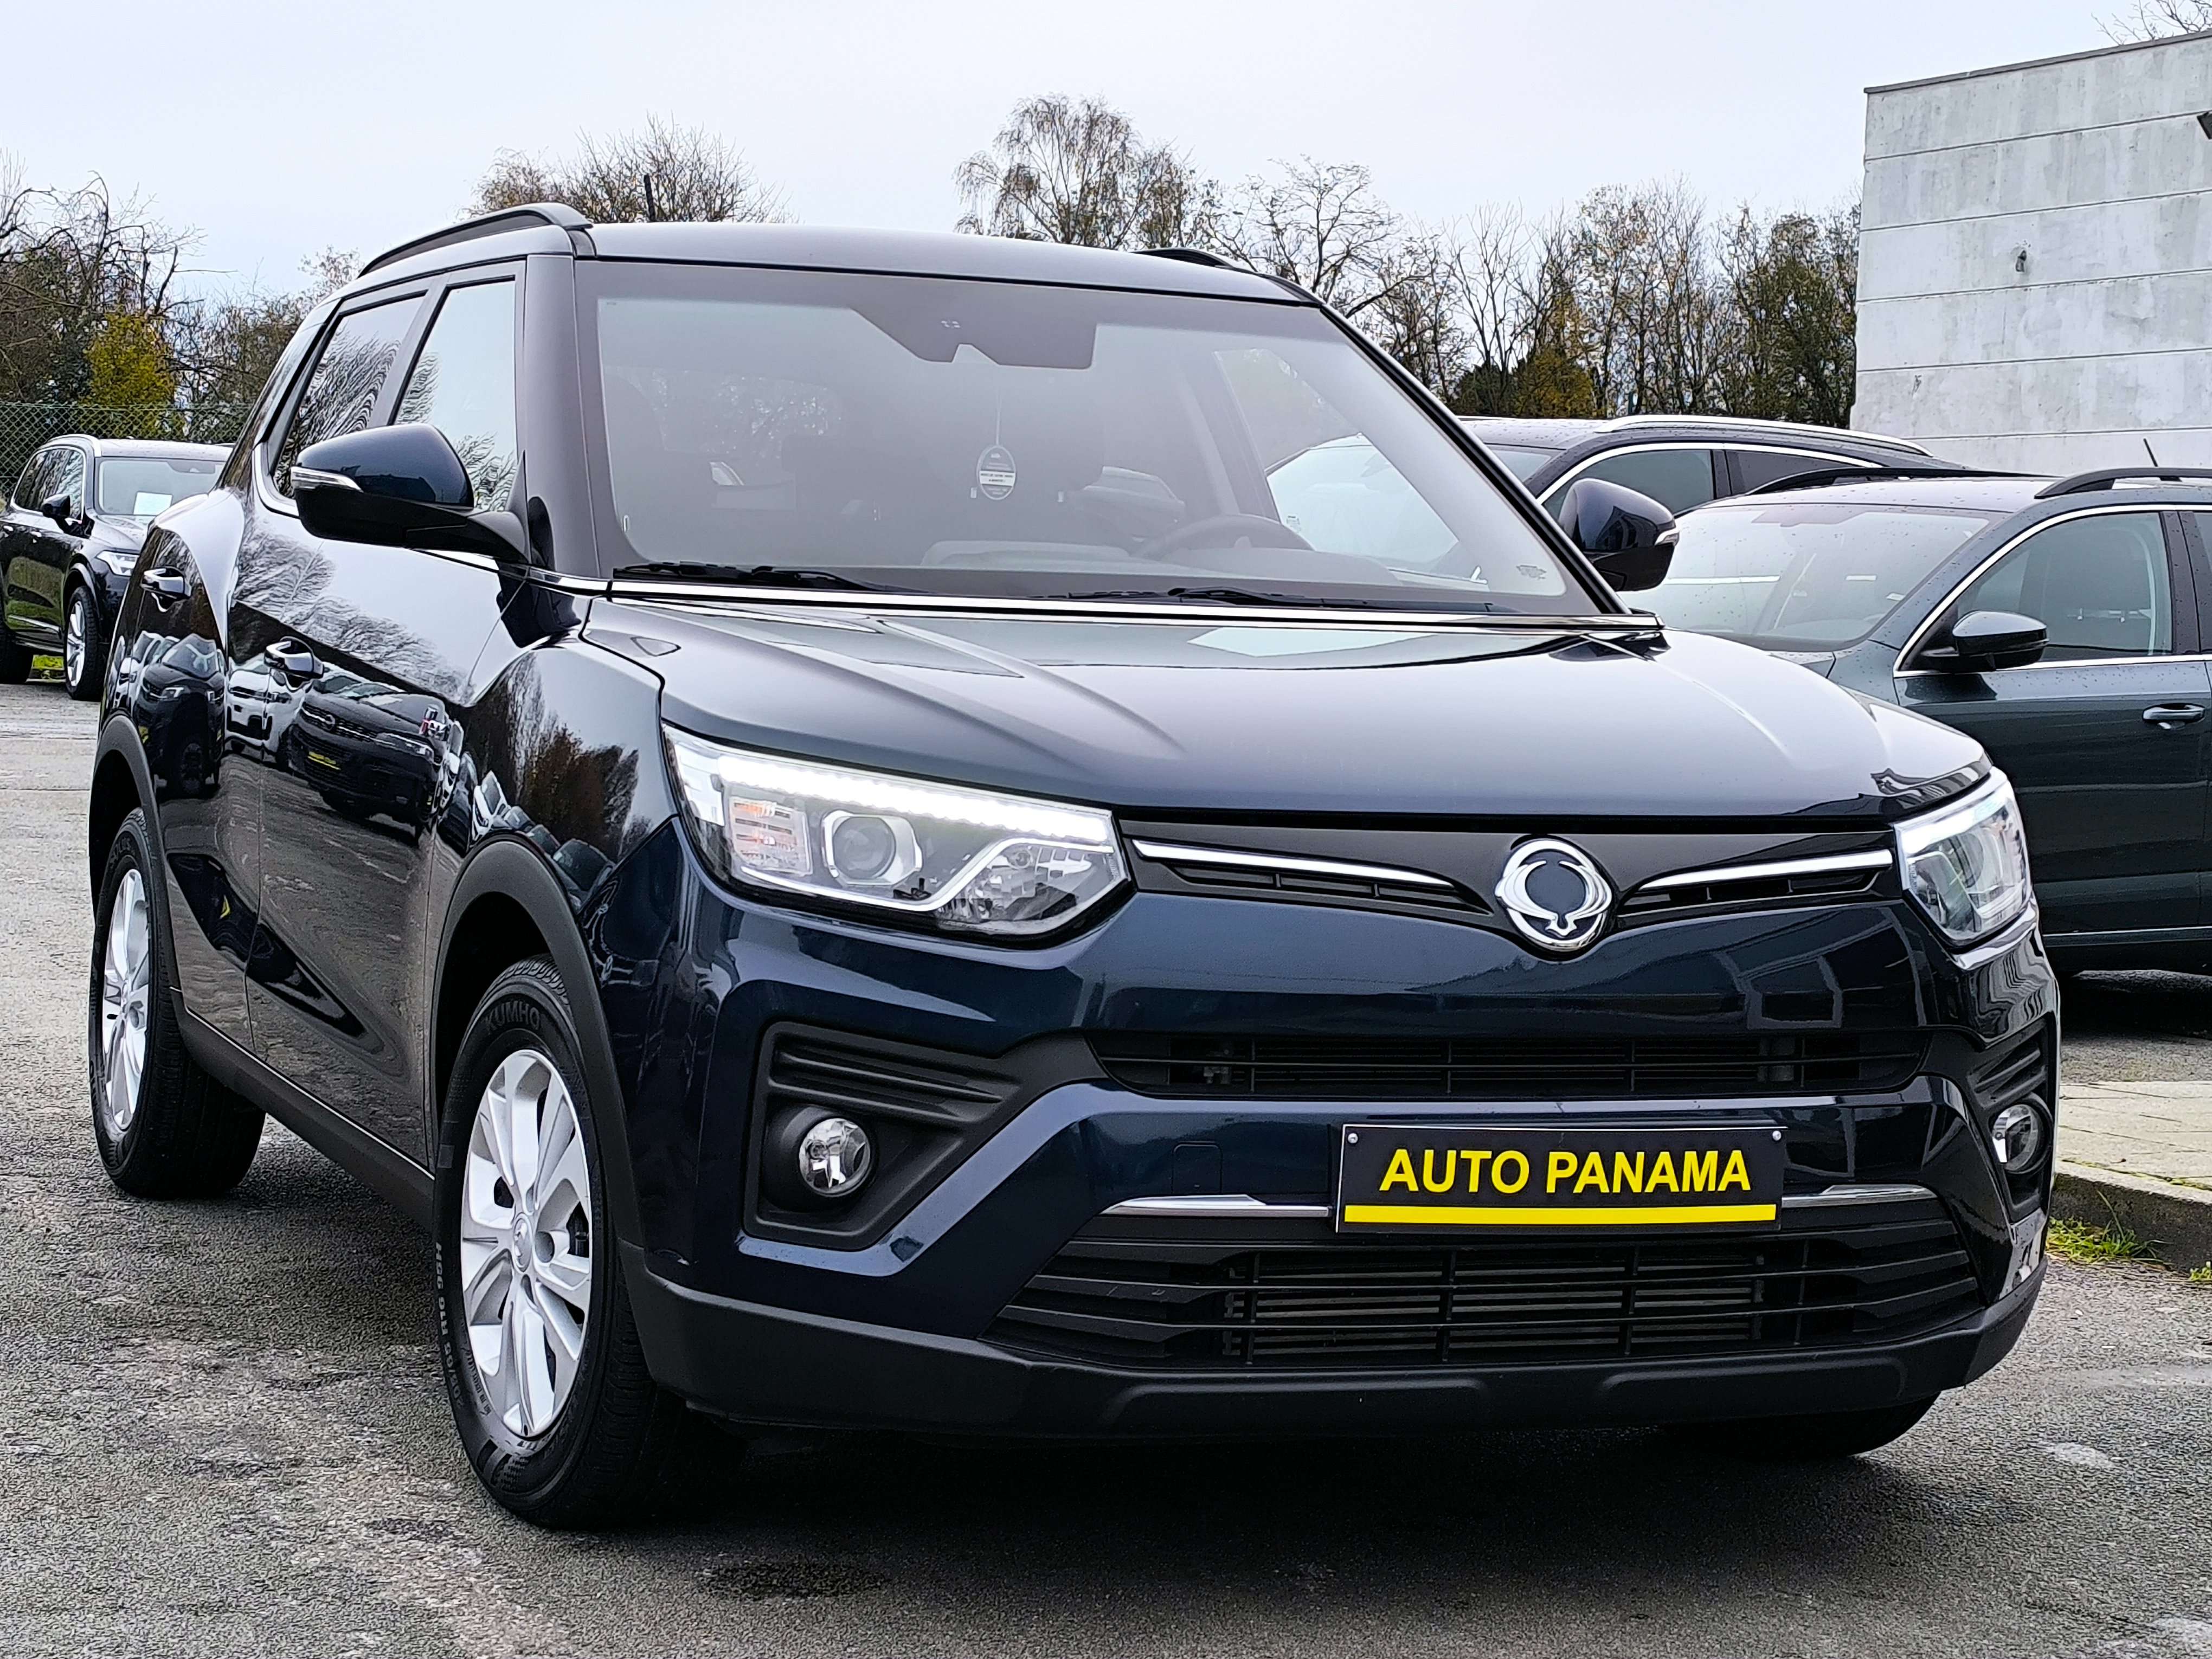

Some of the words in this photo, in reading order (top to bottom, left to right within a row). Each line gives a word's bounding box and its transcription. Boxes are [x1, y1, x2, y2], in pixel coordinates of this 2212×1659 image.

[483, 1000, 539, 1034] KUMHO
[1379, 1148, 1530, 1193] AUTO
[1546, 1149, 1751, 1193] PANAMA
[435, 1241, 443, 1290] 95H
[438, 1296, 448, 1336] R16
